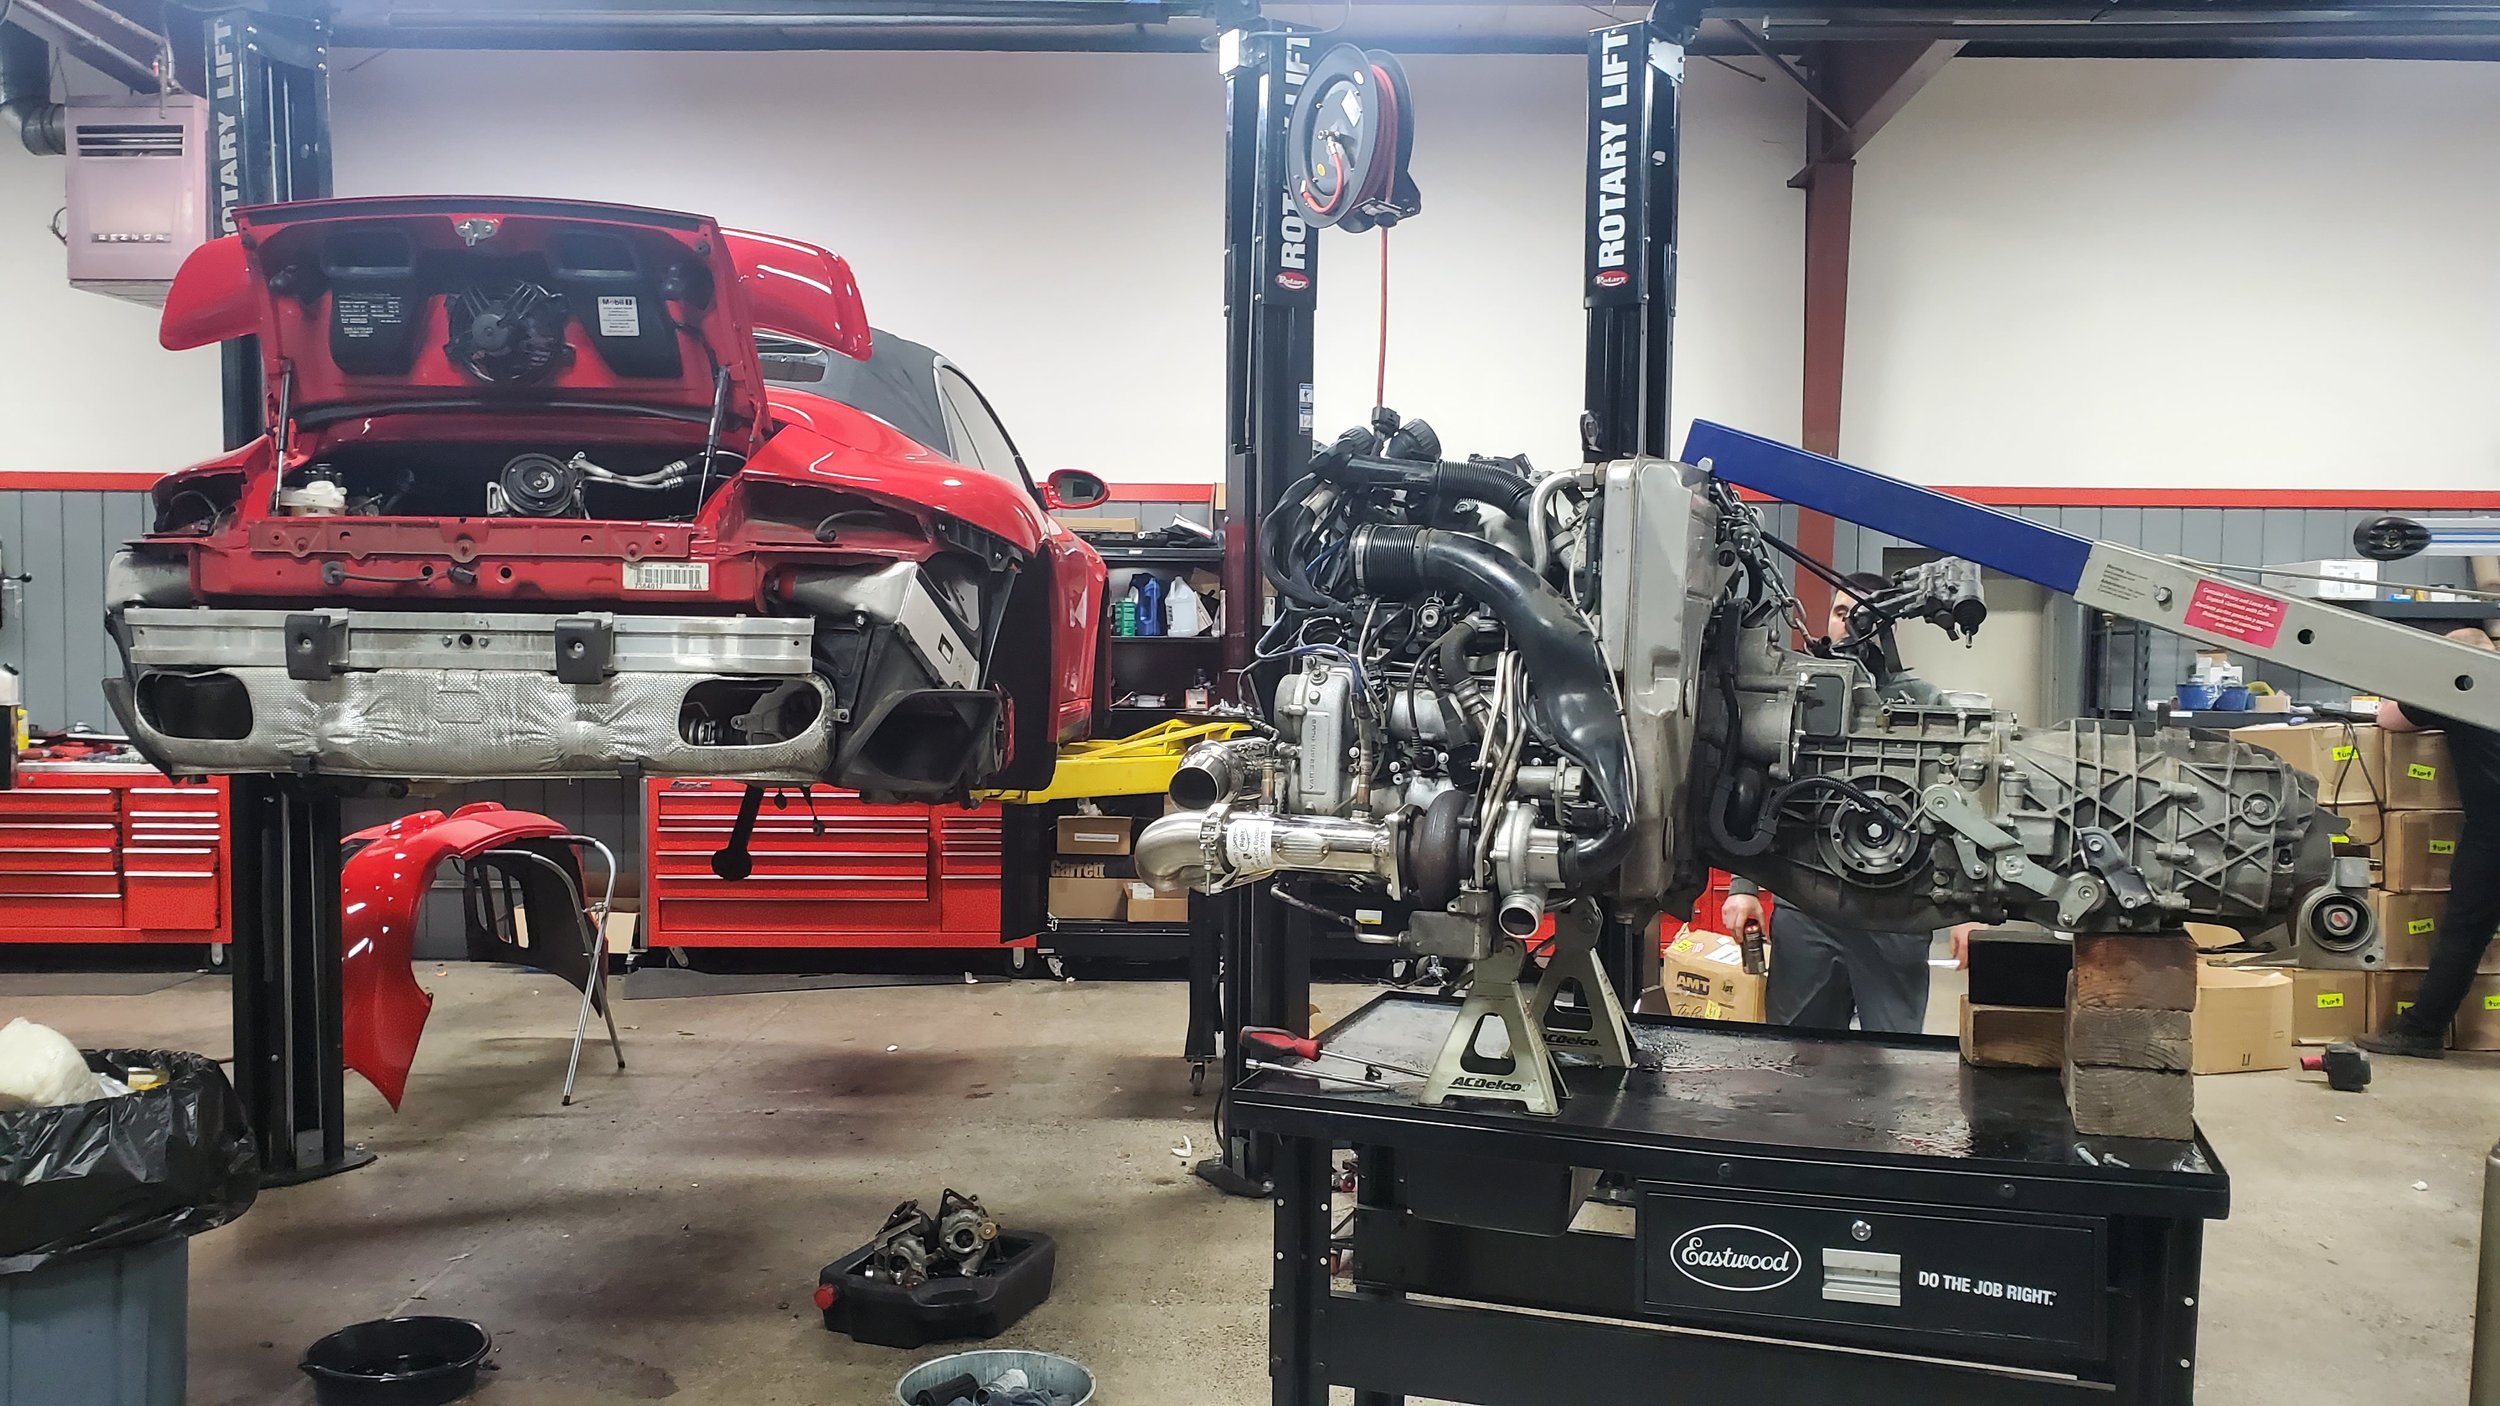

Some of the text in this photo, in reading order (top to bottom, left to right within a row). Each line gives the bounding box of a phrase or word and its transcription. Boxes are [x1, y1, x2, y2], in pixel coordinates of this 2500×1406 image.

[214, 23, 239, 237] OTARY LIFT
[1598, 32, 1628, 268] ROTARY LIFT
[98, 233, 164, 241] REZNOR
[1596, 275, 1626, 286] Rotary
[1050, 860, 1105, 878] Garrett
[1678, 975, 1709, 992] AMT
[1451, 1076, 1522, 1092] ACDelco
[1682, 1236, 1790, 1272] Eastwood
[1918, 1271, 1939, 1288] DO
[1942, 1274, 1971, 1293] THE
[1973, 1280, 2003, 1298] JOB
